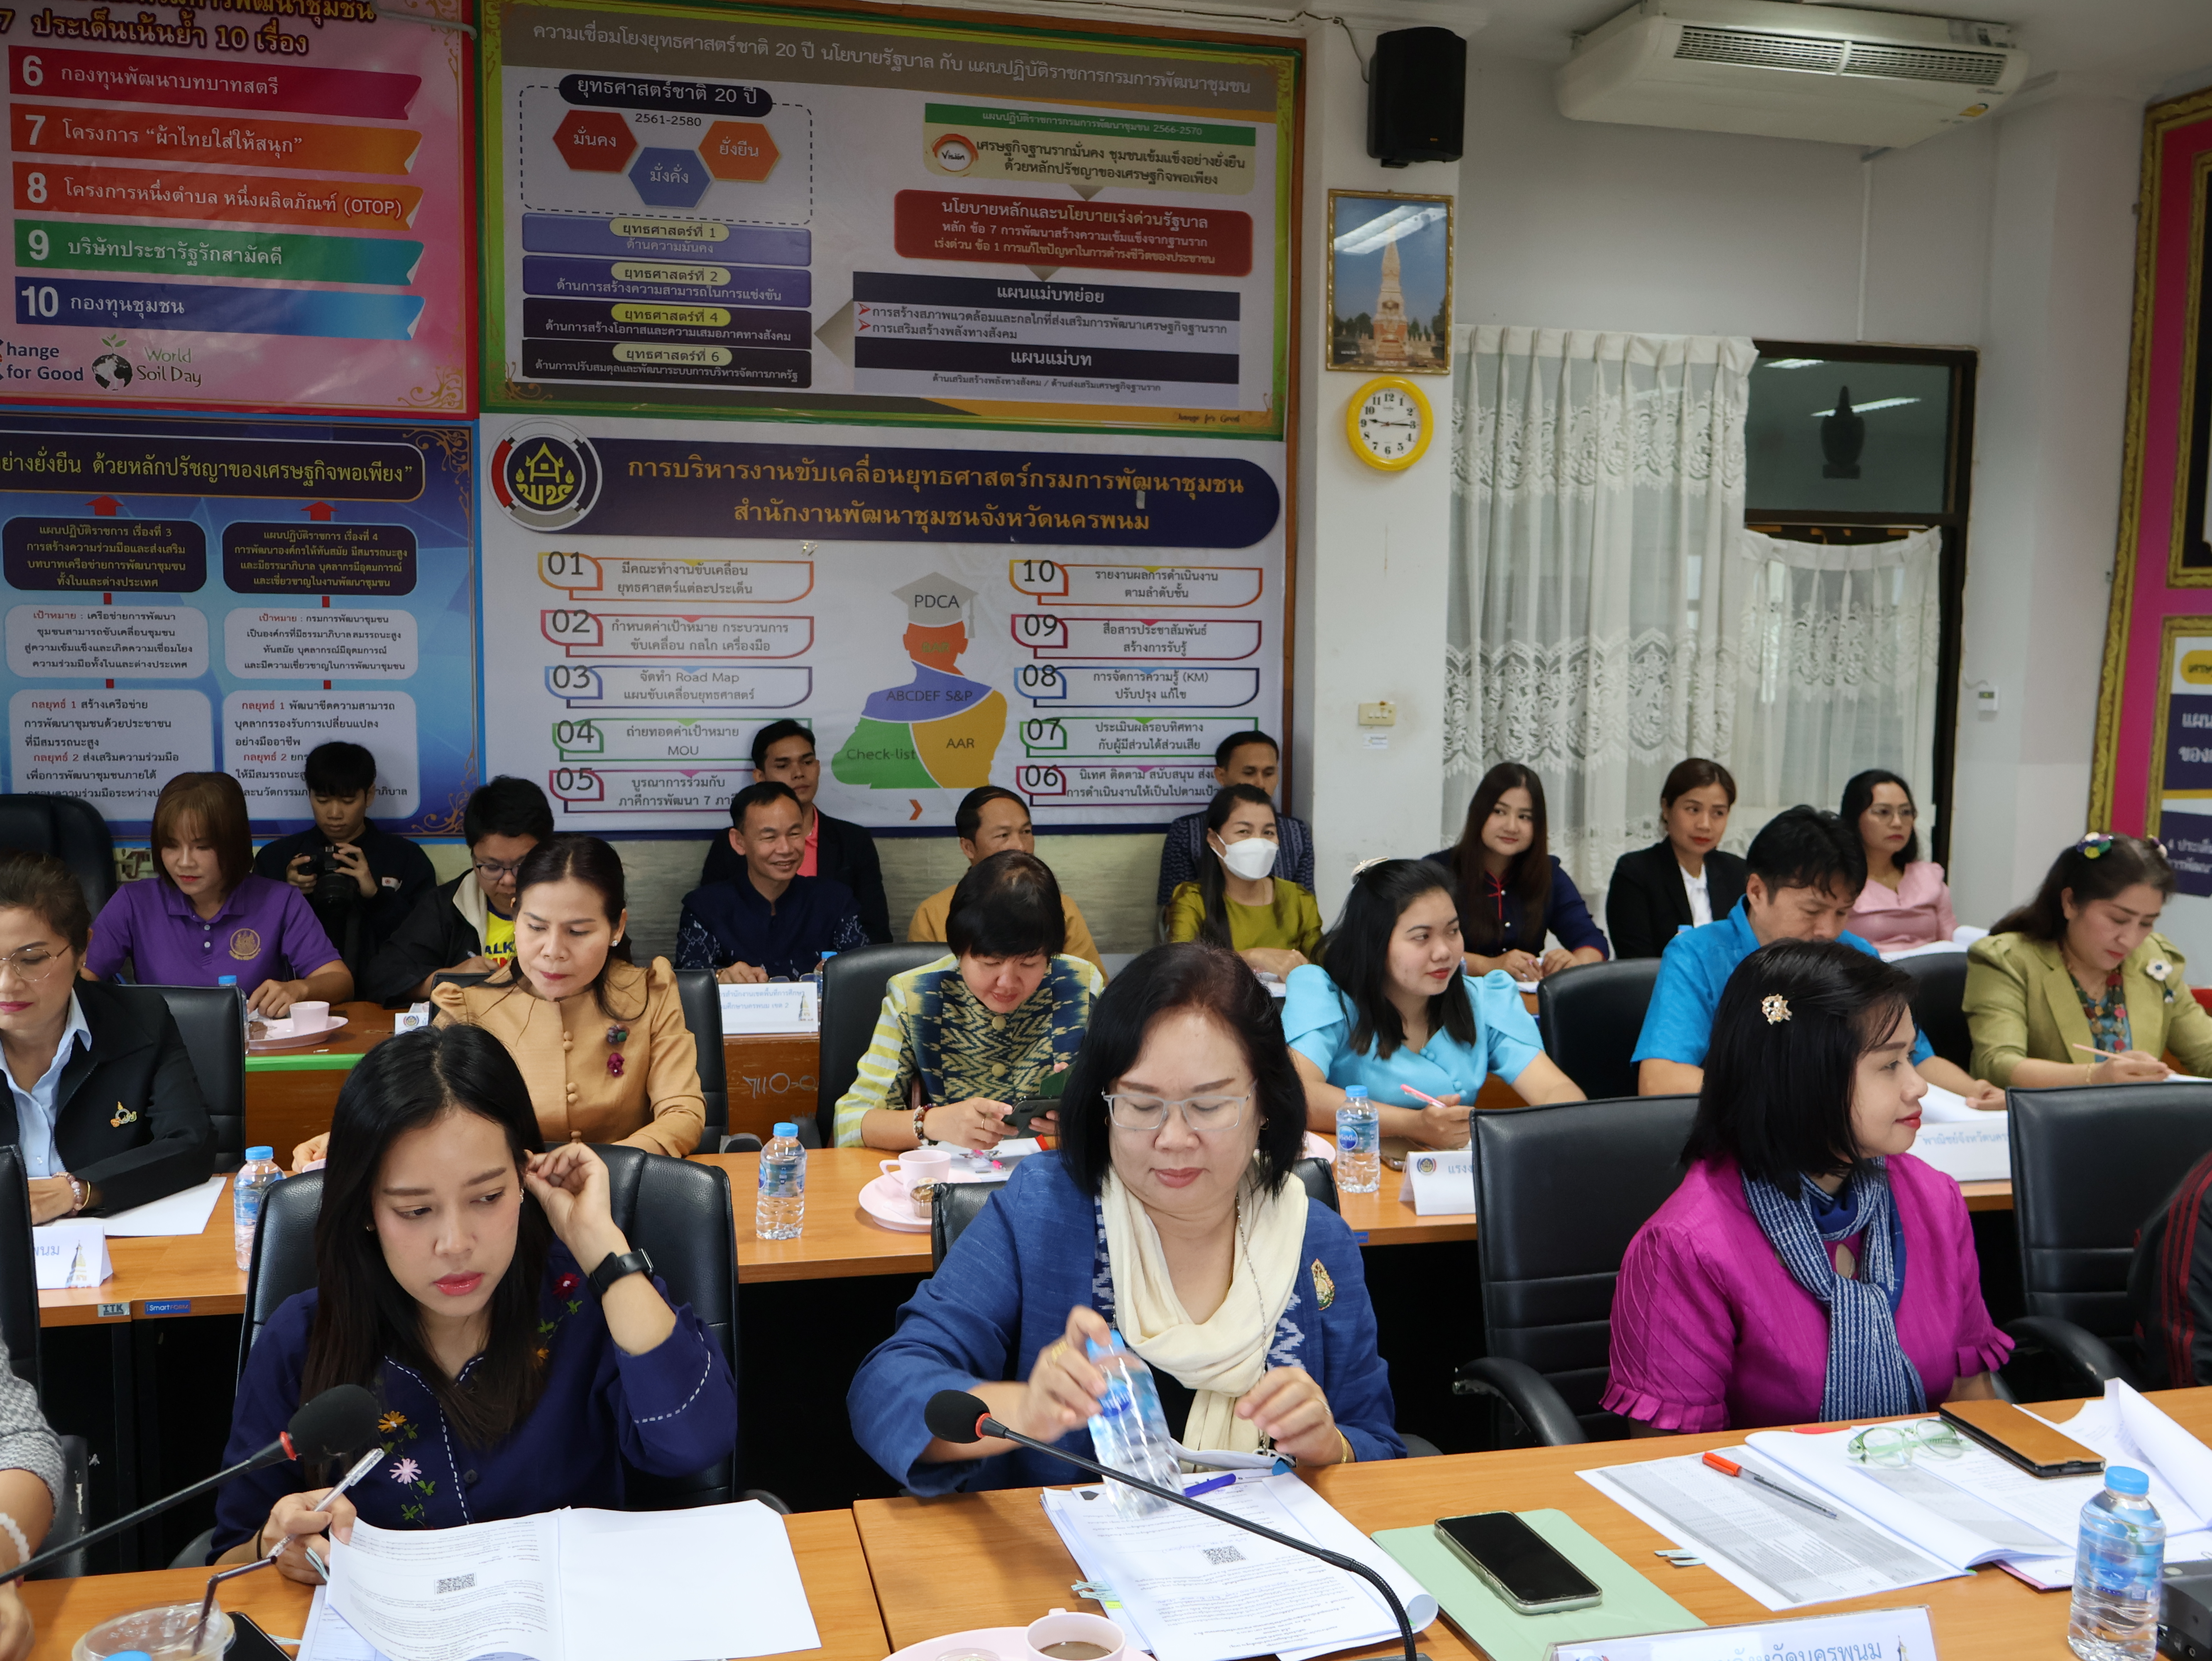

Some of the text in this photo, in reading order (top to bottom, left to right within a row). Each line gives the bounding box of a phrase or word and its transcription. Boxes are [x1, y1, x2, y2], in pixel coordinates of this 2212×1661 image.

[32, 7, 206, 47] ประเด็นเน้นย้ำ
[216, 25, 248, 49] 10
[255, 18, 308, 54] เรื่อง
[533, 21, 1251, 95] ความเชื่อมโยงยุทธศาสตร์ชาติ 20 ปี นโยบายรัฐบาล กับ แผนปฏิบัติราชการกรมการพัฒนาชุมชน
[22, 56, 279, 95] 6 กองทุนพัฒนาบทบาทสตรี
[577, 78, 758, 105] ยุทธศาสตร์ชาติ 20 ปี
[635, 113, 702, 127] 2561-2580
[24, 115, 46, 145] 7
[63, 118, 139, 143] โครงการ
[573, 125, 617, 148] มั่นคง
[1152, 125, 1203, 136] 2566-2570
[719, 137, 759, 158] ยั่งยืน
[650, 163, 689, 184] มั่งคั่ง
[27, 172, 402, 219] 8 โครงการหนึ่งตำบล หนึ่งผลิตภัณฑ์ (OTOP)
[942, 198, 1208, 230] นโยบายหลักและนโยบายเร่งด่วนรัฐบาล
[623, 223, 716, 239] ยุทธศาสตร์ที่ 1
[990, 225, 997, 235] 7
[28, 229, 282, 266] 9 บริษัทประชารัฐรักสามัคคี
[994, 243, 1000, 252] 1
[624, 267, 718, 283] ยุทธศาสตร์ที่ 2
[997, 283, 1104, 304] แผนแม่บทย่อย
[21, 286, 185, 319] 10 กองทุนชุมชน
[624, 308, 718, 324] ยุทธศาสตร์ที่ 4
[144, 346, 191, 364] World
[626, 348, 719, 364] ยุทธศาสตร์ที่ 6
[1011, 350, 1092, 368] แผนแม่บท
[7, 364, 83, 381] for Good
[137, 365, 202, 388] Soil Day
[1373, 397, 1380, 405] 11
[1399, 398, 1403, 406] 1
[1373, 441, 1378, 450] 7
[0, 446, 413, 486] ย่างยั่งยืน ด้วยหลักปรัชญาของเศรษฐกิจพอเพียง”
[628, 453, 1245, 500] การบริหารงานขับเคลื่อนยุทธศาสตร์กรมการพัฒนาชุมชน
[734, 498, 1150, 533] สำนักงานพัฒนาชุมชนจังหวัดนครพนม
[166, 528, 172, 537] 3
[547, 551, 583, 576] 01
[622, 561, 748, 576] มีคณะทำงานขับเคลื่อน
[1023, 559, 1055, 583] 10
[1095, 568, 1219, 581] รายงานผลการดำเนินงาน
[618, 581, 753, 596] ยุทธศาสตร์แต่ละประเด็น
[914, 595, 959, 608] PDCA
[552, 609, 590, 633] 02
[612, 619, 788, 634] กำหนดค่าเป้าหมาย กระบวนการ
[1024, 614, 1058, 637] 09
[1103, 622, 1207, 636] สื่อสารประชาสัมพันธ์
[631, 637, 770, 652] ขับเคลื่อน กลไก เครื่องมือ
[553, 665, 591, 689] 03
[640, 670, 740, 685] จัดทำ Road Map
[1023, 664, 1057, 687] 08
[1183, 671, 1209, 683] (KM)
[624, 686, 755, 703] แผนขับเคลื่อนยุทธศาสตร์
[886, 691, 973, 702] ABCDEF S&P
[1115, 688, 1156, 702] ปรับปรุง
[32, 698, 66, 711] กลยุทธ์
[242, 700, 275, 712] กลยุทธ์
[557, 720, 595, 744] 04
[626, 724, 739, 737] ถ่ายทอดค่าเป้าหมาย
[1027, 718, 1061, 741] 07
[668, 746, 699, 756] MOU
[946, 738, 975, 748] AAR
[34, 752, 68, 764] กลยุทธ์
[244, 752, 276, 763] กลยุทธ์
[847, 749, 917, 760] Check-list
[556, 767, 594, 791] 05
[1025, 764, 1059, 787] 06
[1080, 768, 1106, 780] นิเทศ
[619, 795, 710, 807] ภาคีการพัฒนา 7
[103, 1304, 123, 1313] ITK
